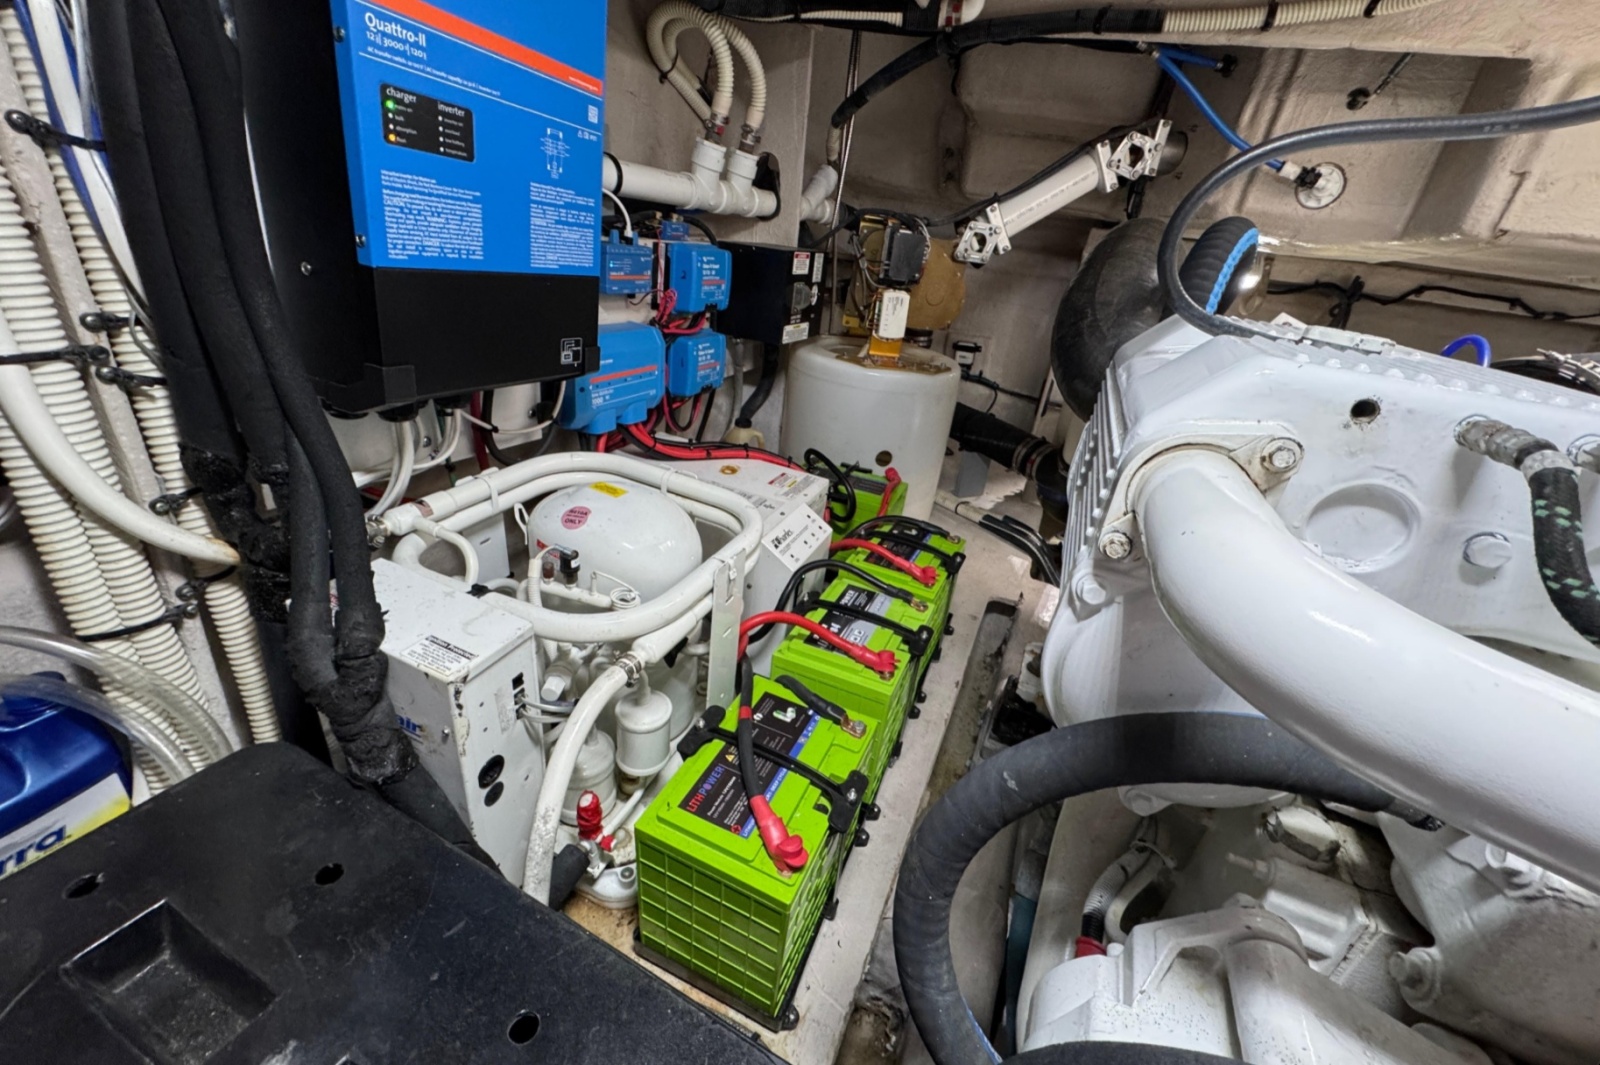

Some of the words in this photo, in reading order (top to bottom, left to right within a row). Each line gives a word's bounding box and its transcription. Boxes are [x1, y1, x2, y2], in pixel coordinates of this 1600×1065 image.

[365, 12, 426, 47] Quattro-II
[386, 87, 417, 104] charger
[437, 101, 465, 117] inverter
